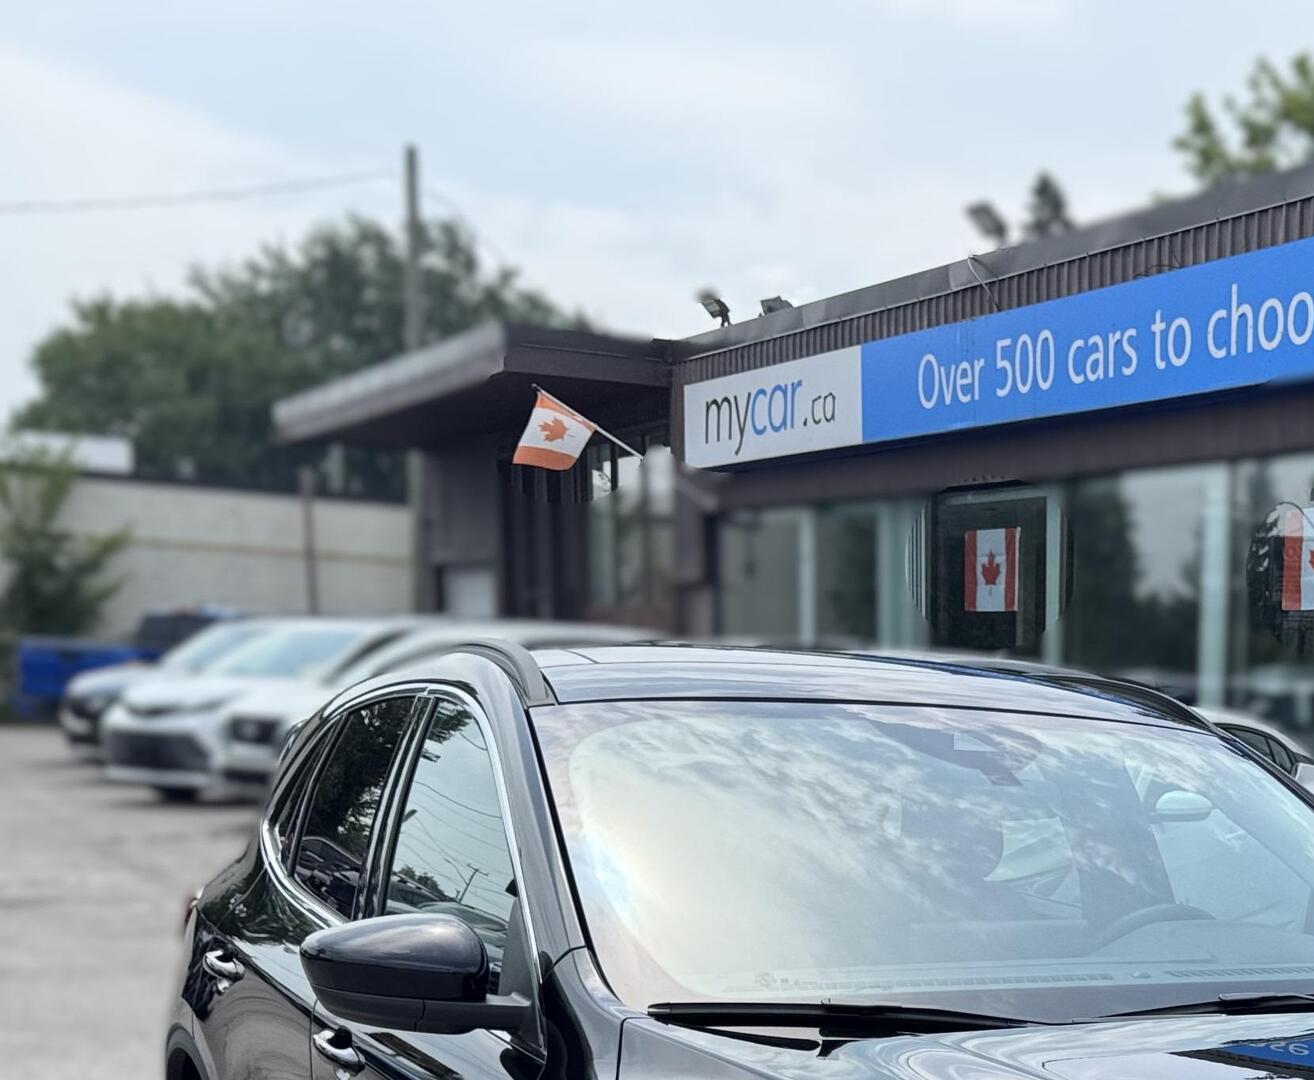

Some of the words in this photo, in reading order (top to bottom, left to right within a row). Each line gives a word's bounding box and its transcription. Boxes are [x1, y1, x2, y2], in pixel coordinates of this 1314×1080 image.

[917, 353, 985, 410] Over
[996, 329, 1055, 398] 500
[1067, 327, 1138, 385] cars
[1151, 309, 1192, 370] to
[704, 377, 837, 457] mycar.ca
